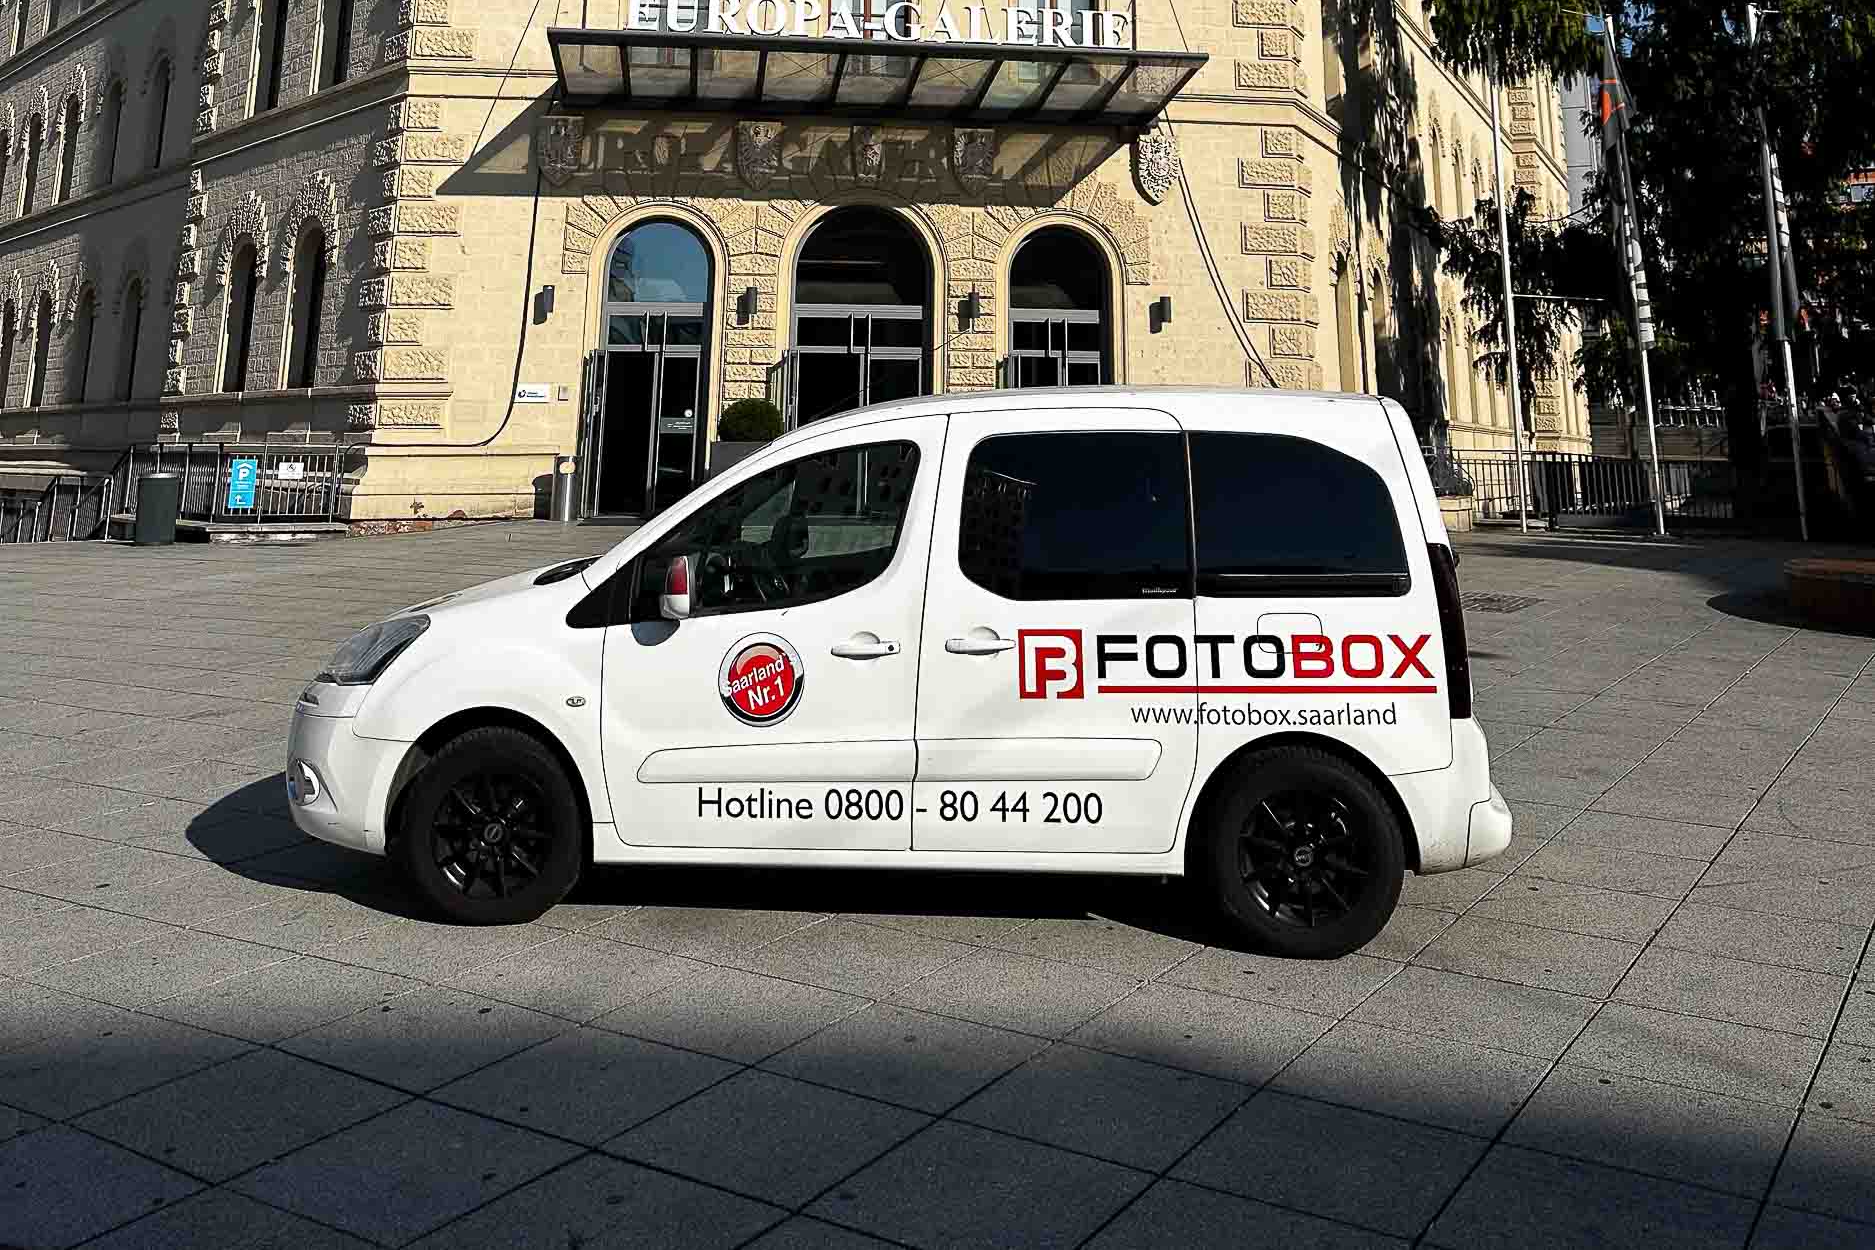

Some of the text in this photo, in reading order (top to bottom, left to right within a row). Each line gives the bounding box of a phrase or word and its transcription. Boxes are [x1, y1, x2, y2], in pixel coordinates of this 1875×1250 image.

[239, 468, 251, 481] P
[1096, 634, 1435, 680] FOTOBOX
[1130, 702, 1398, 727] www.fotobox.saarland
[697, 787, 814, 819] Hotline
[824, 789, 905, 821] 0800
[938, 790, 980, 823] 80
[989, 791, 1031, 823] 44
[1042, 792, 1104, 825] 200
